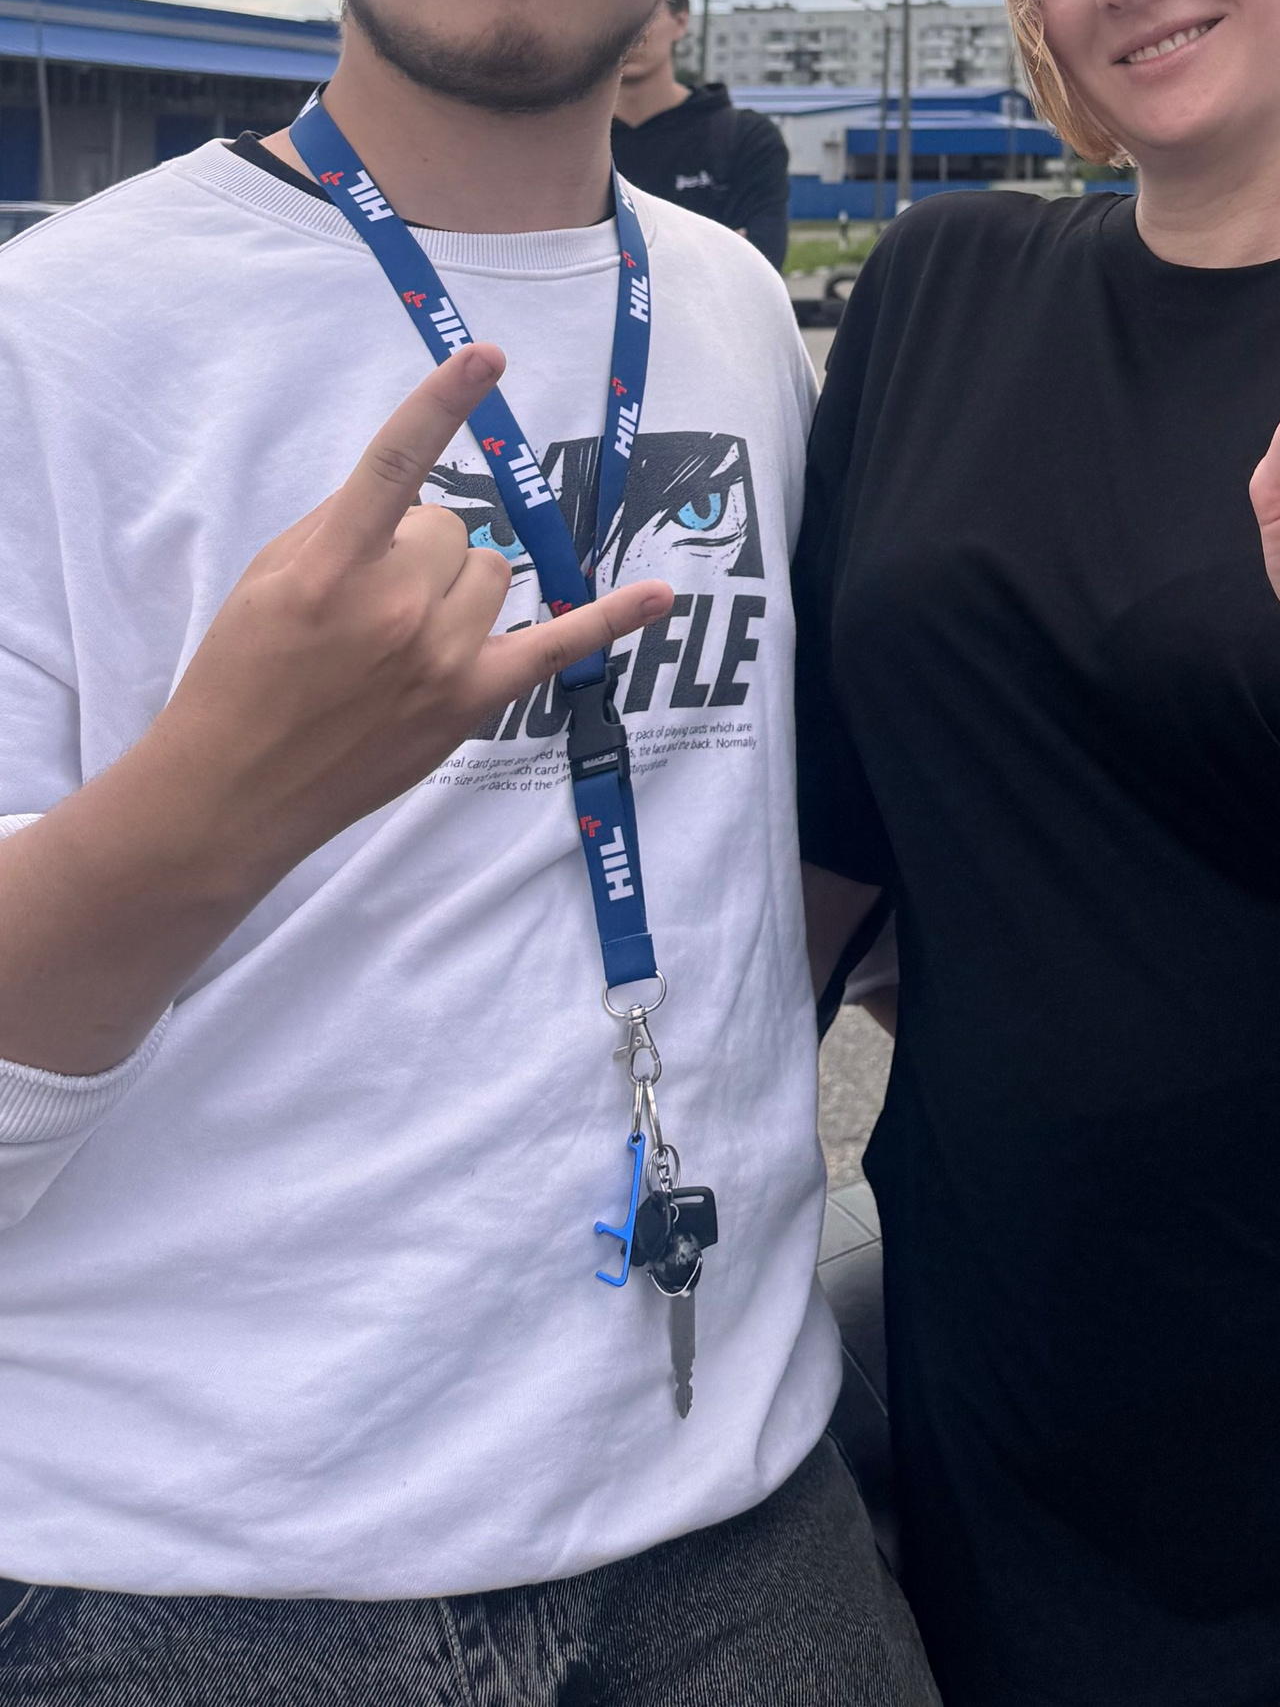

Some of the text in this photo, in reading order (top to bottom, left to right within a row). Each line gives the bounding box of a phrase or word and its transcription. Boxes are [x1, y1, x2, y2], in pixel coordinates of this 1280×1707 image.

[347, 169, 395, 222] HIL
[629, 275, 649, 324] HIL
[614, 401, 640, 460] HIL
[507, 443, 553, 510] HIL
[709, 721, 735, 733] which
[736, 722, 753, 732] are
[454, 773, 473, 786] size
[534, 763, 560, 776] card
[716, 735, 758, 751] Normally
[520, 779, 533, 791] of
[535, 779, 553, 792] the
[599, 825, 635, 902] HIL
